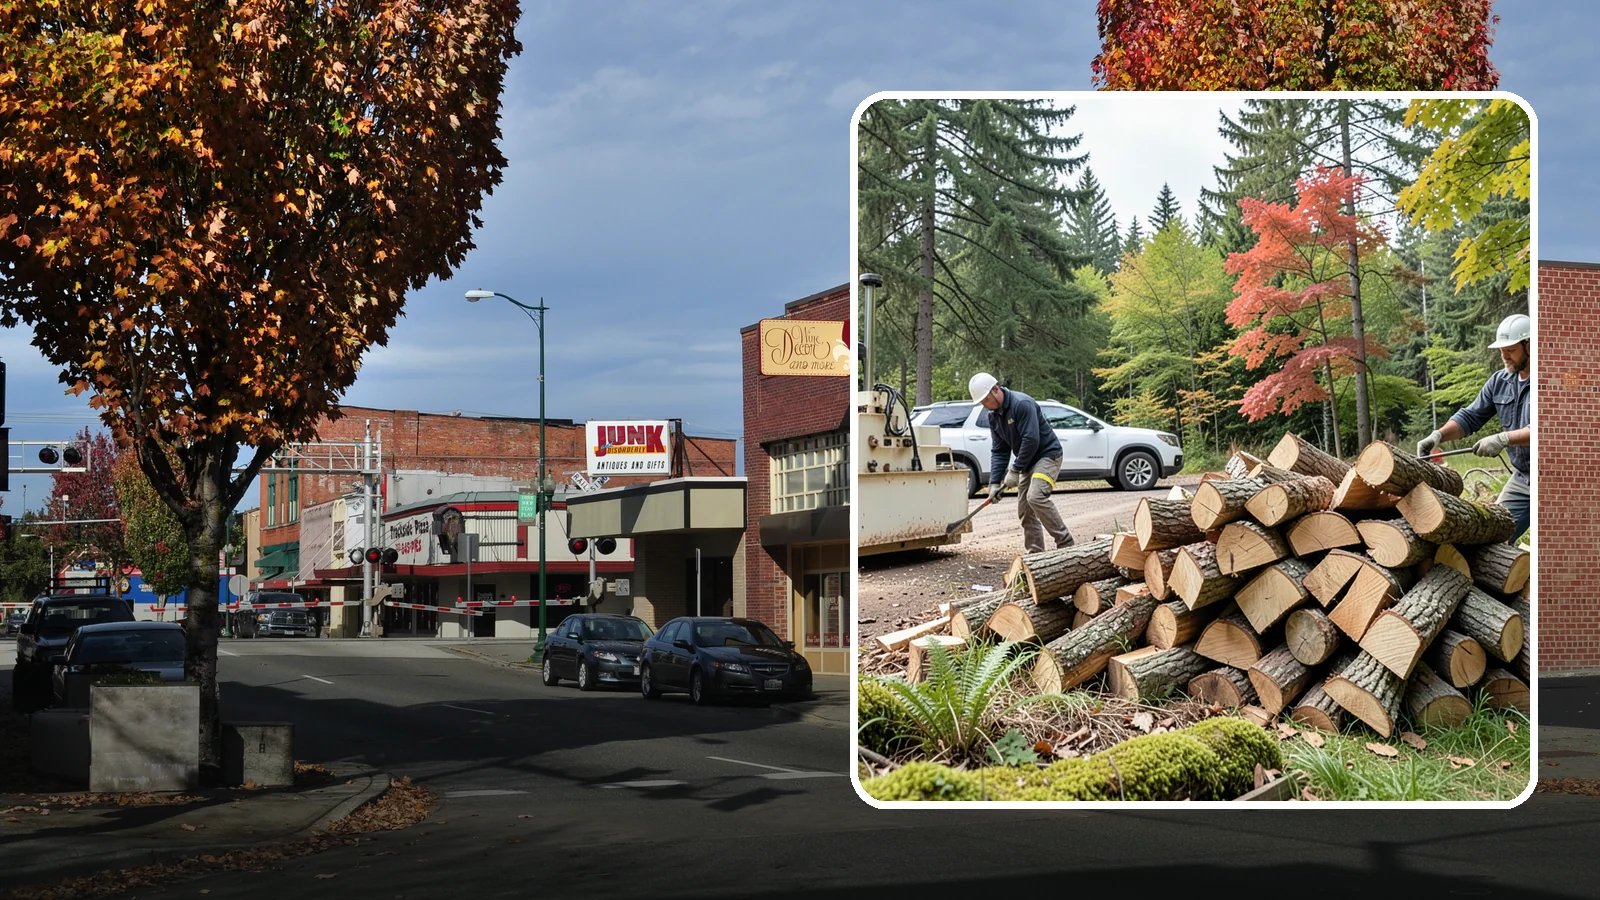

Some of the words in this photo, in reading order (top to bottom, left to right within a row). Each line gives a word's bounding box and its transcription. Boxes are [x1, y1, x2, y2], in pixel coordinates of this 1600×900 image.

[596, 425, 664, 457] JUNK
[607, 446, 645, 454] DISORDERLY
[597, 461, 628, 470] ANTIQUES
[631, 461, 644, 469] AND
[647, 460, 665, 469] GIFTS
